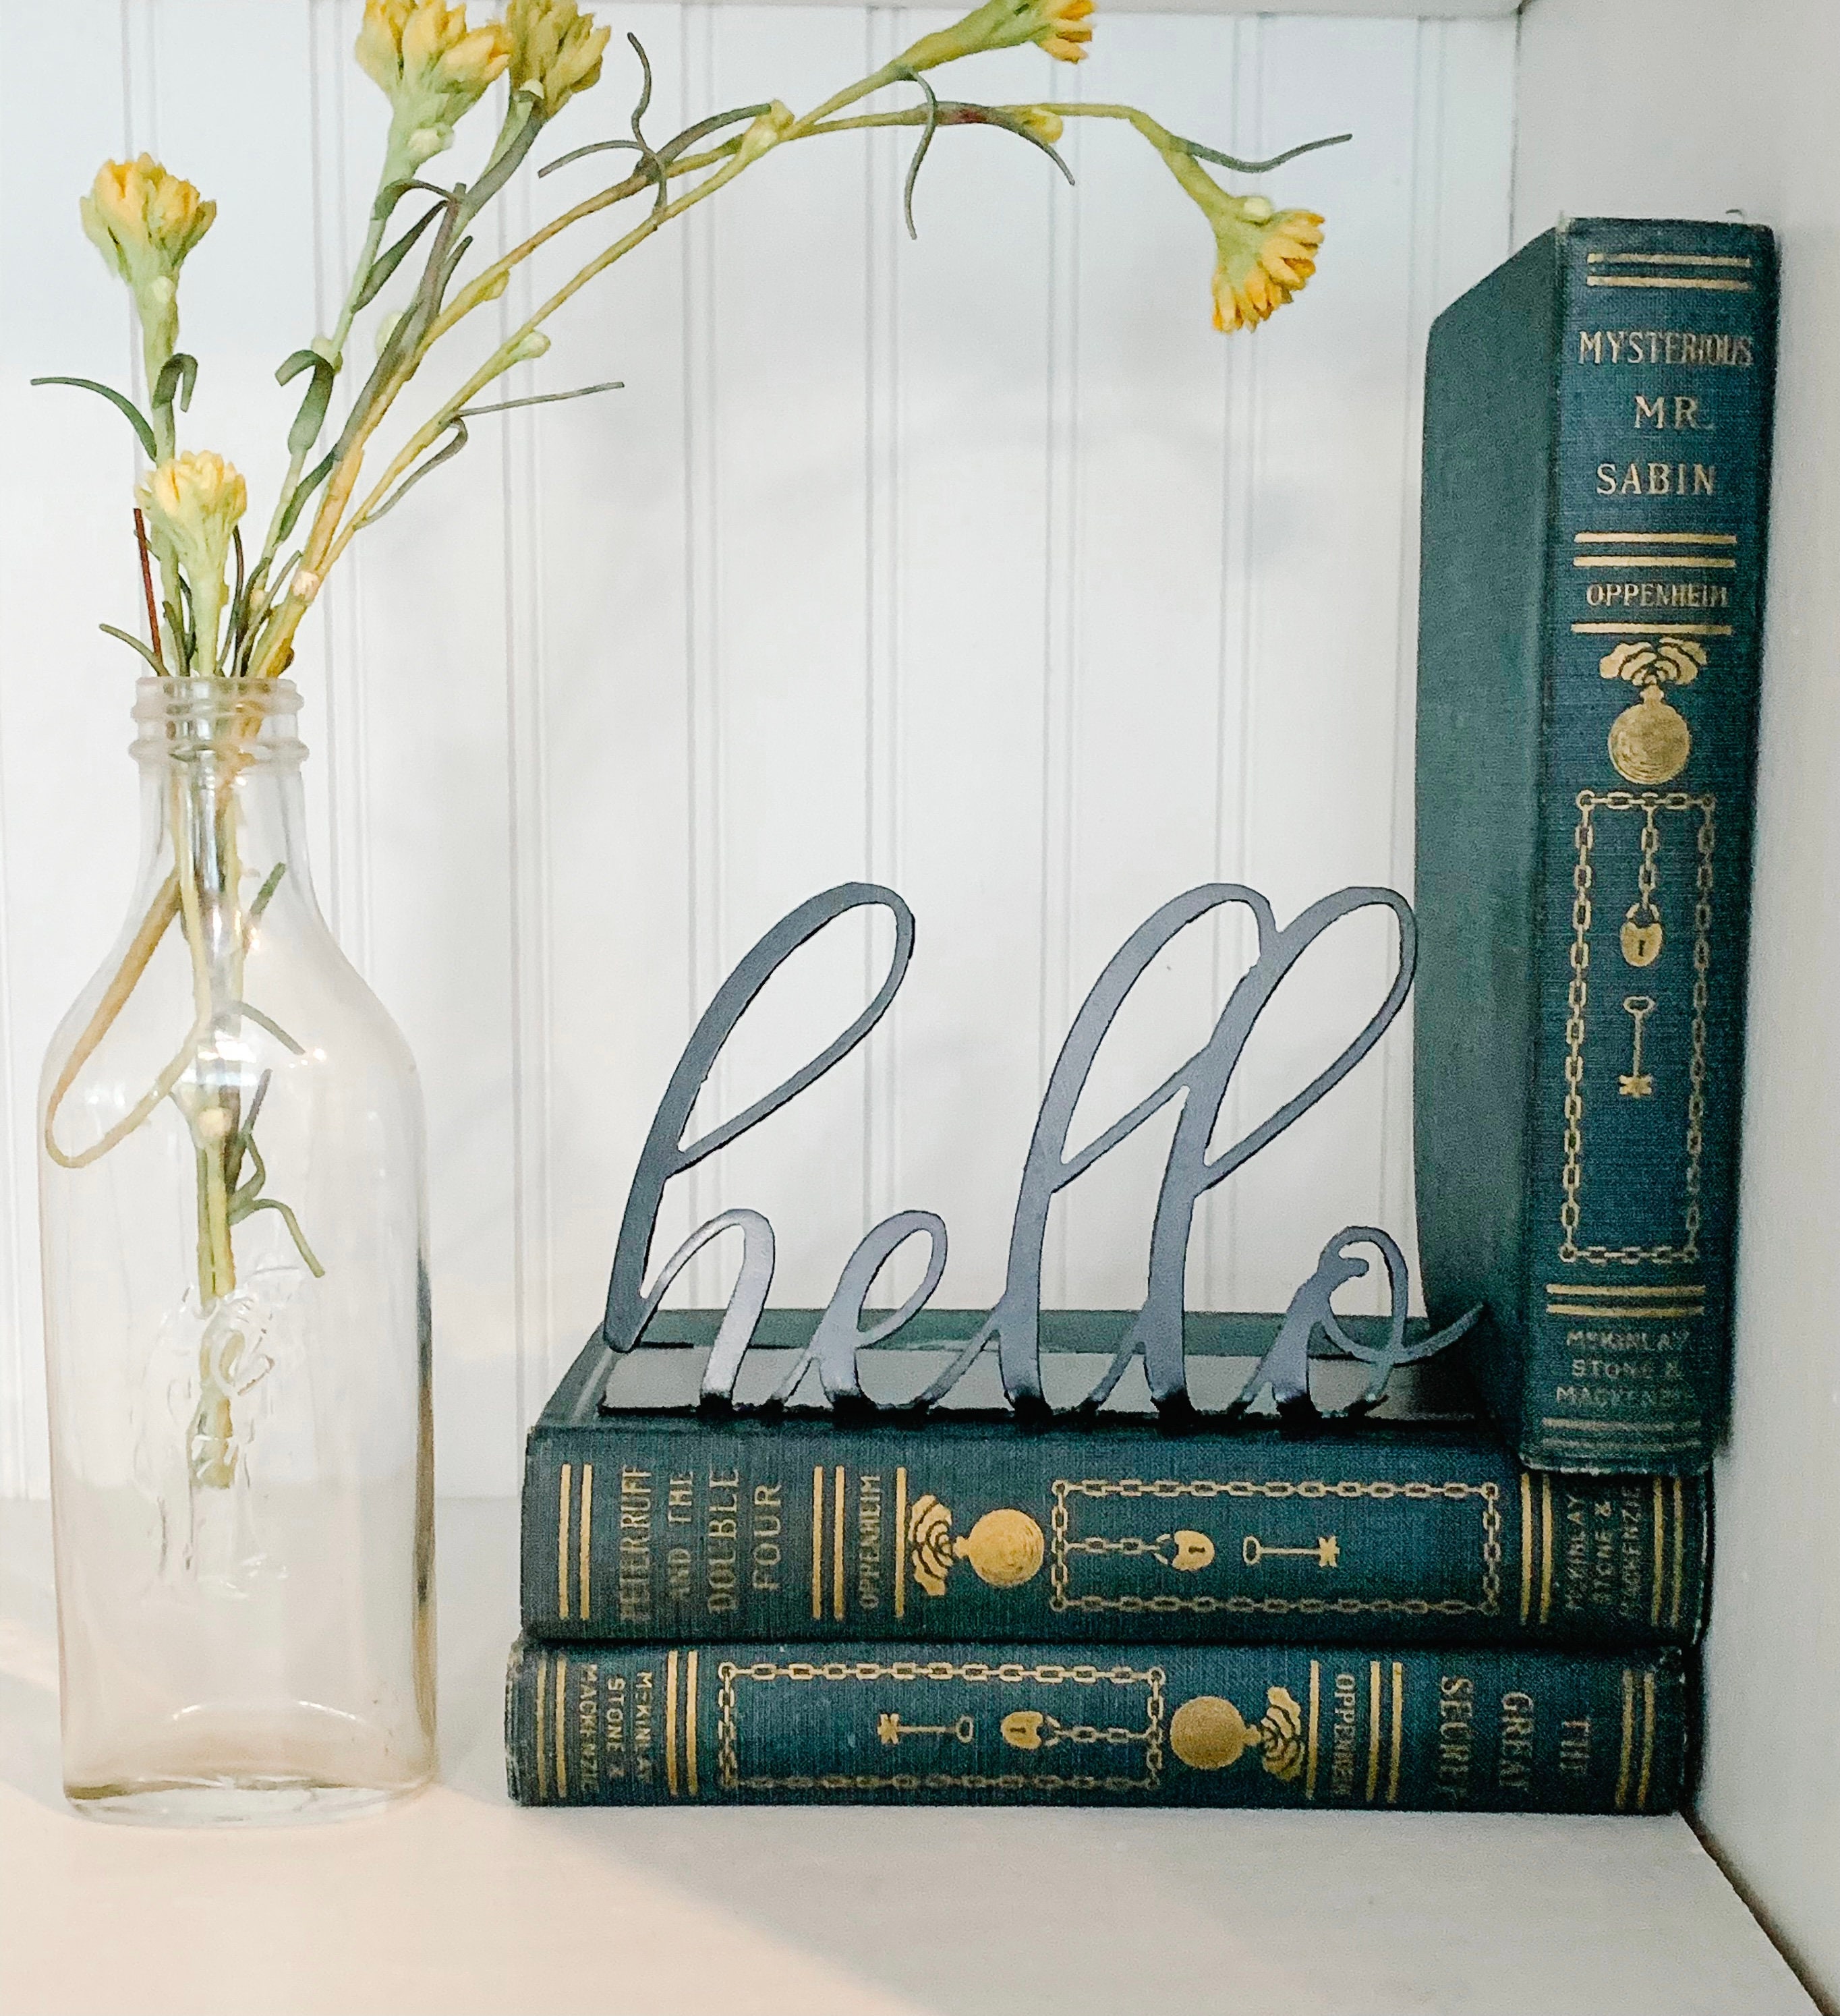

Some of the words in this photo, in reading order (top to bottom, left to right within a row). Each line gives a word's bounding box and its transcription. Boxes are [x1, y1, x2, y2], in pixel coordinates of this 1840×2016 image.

[1578, 330, 1754, 366] MYSTERIOUS
[1595, 463, 1715, 496] SABIN
[1586, 583, 1729, 607] OPPENHEIM
[603, 882, 1485, 1417] hello
[1572, 1358, 1654, 1379] STONE
[619, 1464, 652, 1528] RUFF
[667, 1470, 694, 1526] THE
[707, 1468, 740, 1615] DOUBLE
[752, 1481, 782, 1591] FOUR
[858, 1474, 882, 1610] OPPENHEIM
[667, 1548, 691, 1600] AND
[579, 1663, 598, 1794] MACKENZIE
[606, 1677, 627, 1753] STONE
[1499, 1692, 1534, 1793] GREAT
[1559, 1716, 1592, 1775] THE
